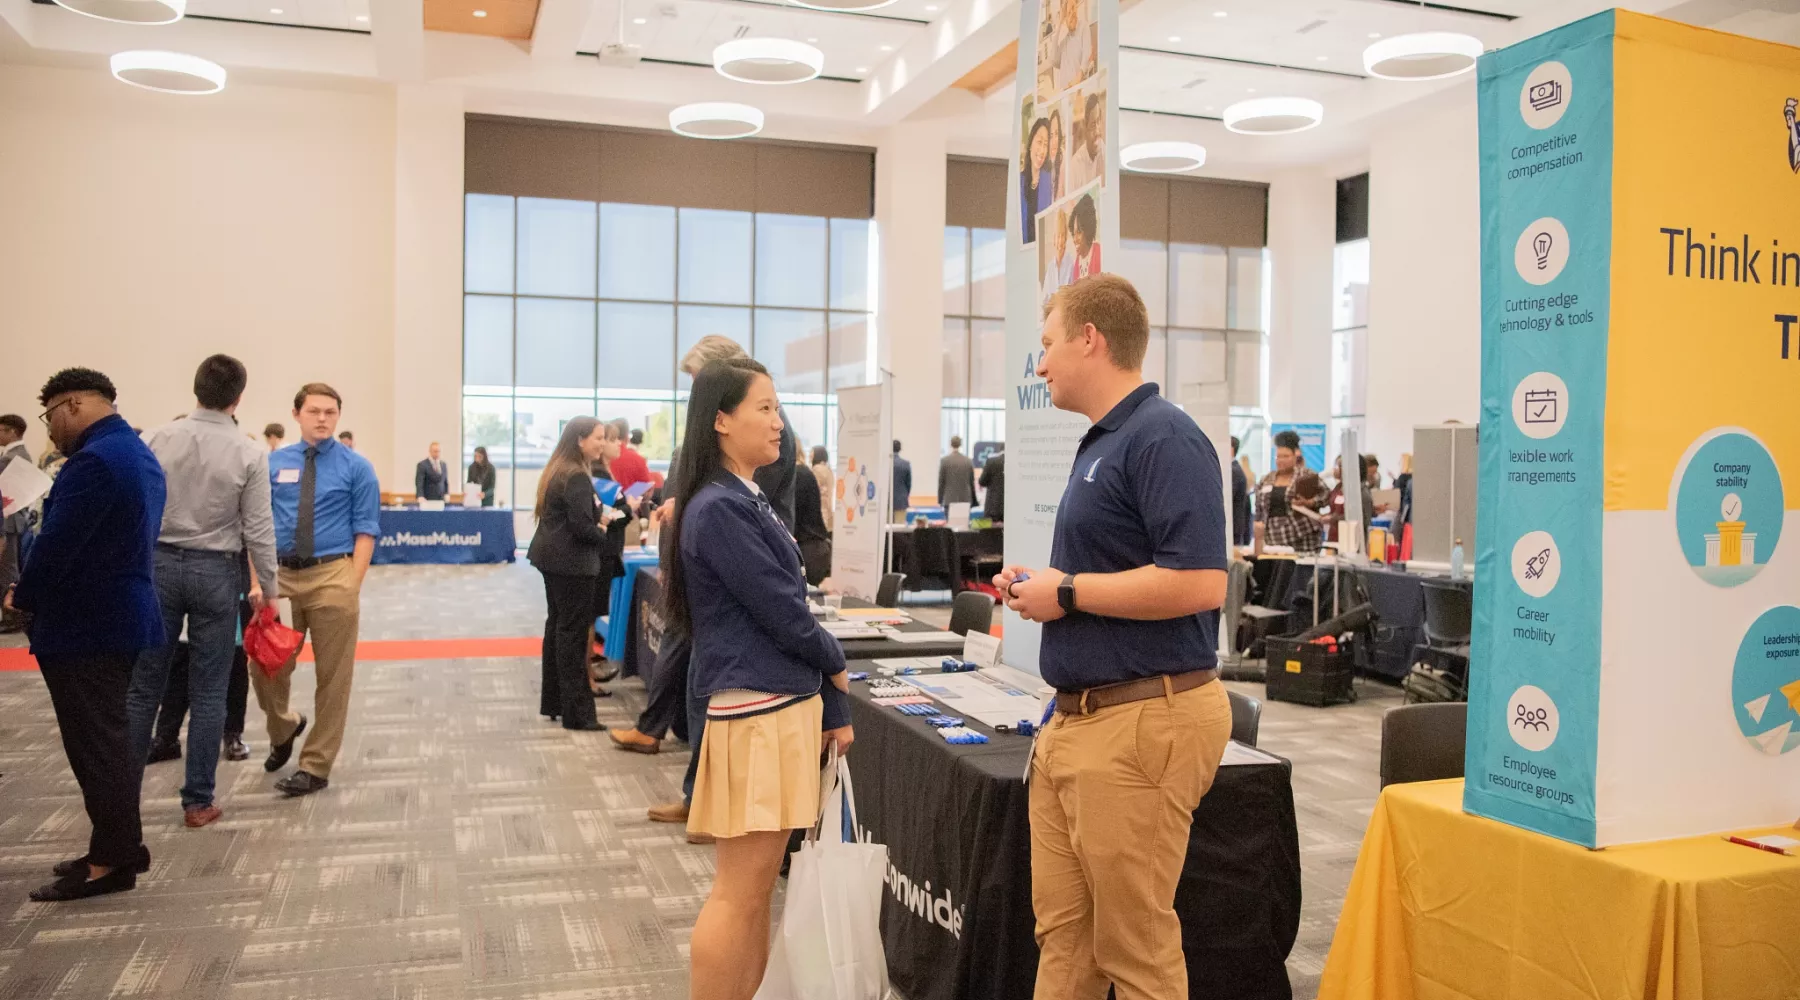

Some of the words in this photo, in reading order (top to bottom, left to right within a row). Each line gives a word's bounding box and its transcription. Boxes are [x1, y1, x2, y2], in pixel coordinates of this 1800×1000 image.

[1511, 132, 1577, 160] Competitive
[1507, 151, 1583, 180] compensation
[1660, 227, 1761, 284] Think
[1505, 297, 1545, 312] Cutting
[1547, 293, 1578, 309] edge
[1555, 313, 1564, 326] &
[1568, 309, 1594, 325] tools
[1774, 314, 1800, 361] T
[1024, 352, 1035, 378] A
[1508, 448, 1547, 463] lexible
[1549, 448, 1574, 463] work
[1507, 470, 1576, 486] rrangements
[1713, 463, 1751, 477] Company
[1716, 476, 1748, 489] stability
[1041, 504, 1058, 513] SOMET
[396, 531, 482, 546] MassMutual
[1517, 606, 1550, 622] Career
[1513, 625, 1556, 646] mobility
[1766, 648, 1800, 660] exposure
[1503, 755, 1557, 781] Employee
[1488, 771, 1534, 794] resource
[1535, 782, 1575, 806] groups
